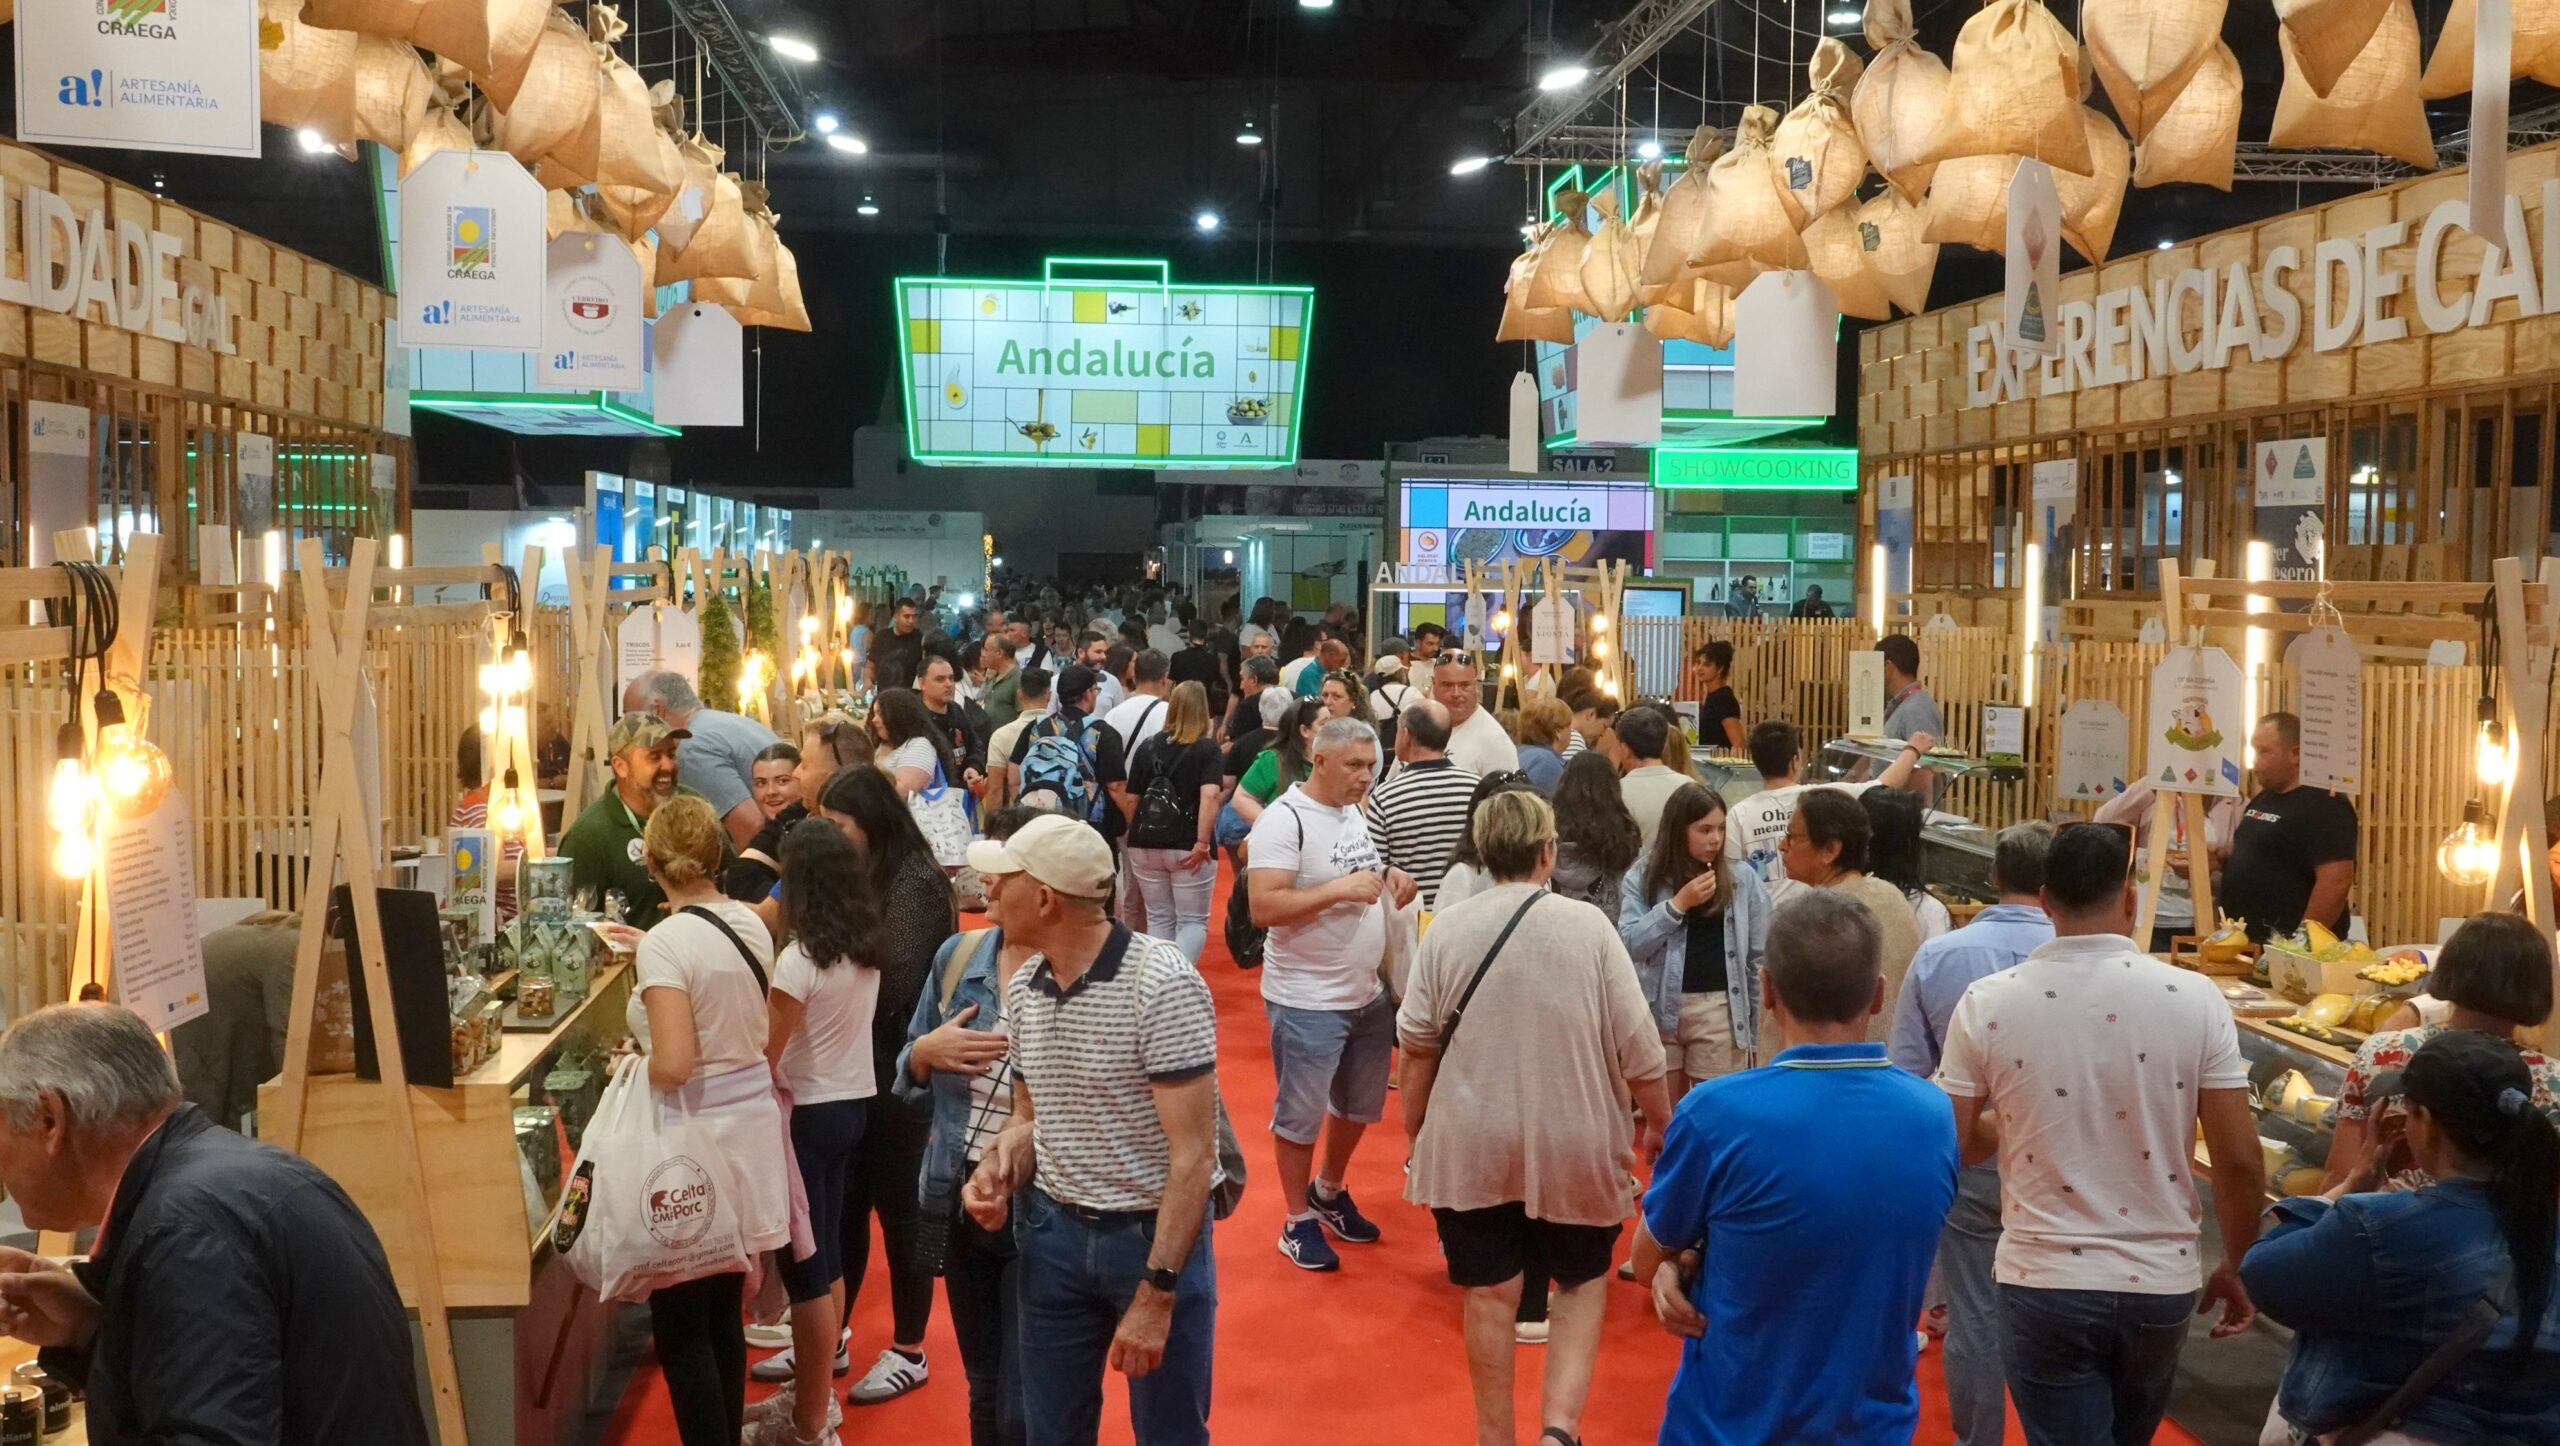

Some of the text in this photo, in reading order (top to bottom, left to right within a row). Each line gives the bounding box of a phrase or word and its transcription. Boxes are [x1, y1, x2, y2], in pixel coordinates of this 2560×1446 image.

[97, 20, 177, 40] CRAEGA
[58, 68, 103, 107] a!
[120, 78, 202, 94] ARTESANÍA
[120, 91, 219, 110] ALIMENTARIA
[447, 268, 496, 280] CRAEGA
[2313, 221, 2411, 353] DE
[2416, 180, 2560, 332] CA
[423, 300, 450, 324] a!
[460, 314, 520, 323] ALIMENTARIA
[996, 335, 1215, 379] Andalucía
[1552, 458, 1614, 473] SALA-2
[1670, 458, 1850, 480] SHOWCOOKING
[1464, 498, 1591, 523] Andalucía
[1762, 809, 1793, 822] Oha
[670, 1183, 706, 1204] Celta
[673, 1201, 703, 1220] Porc
